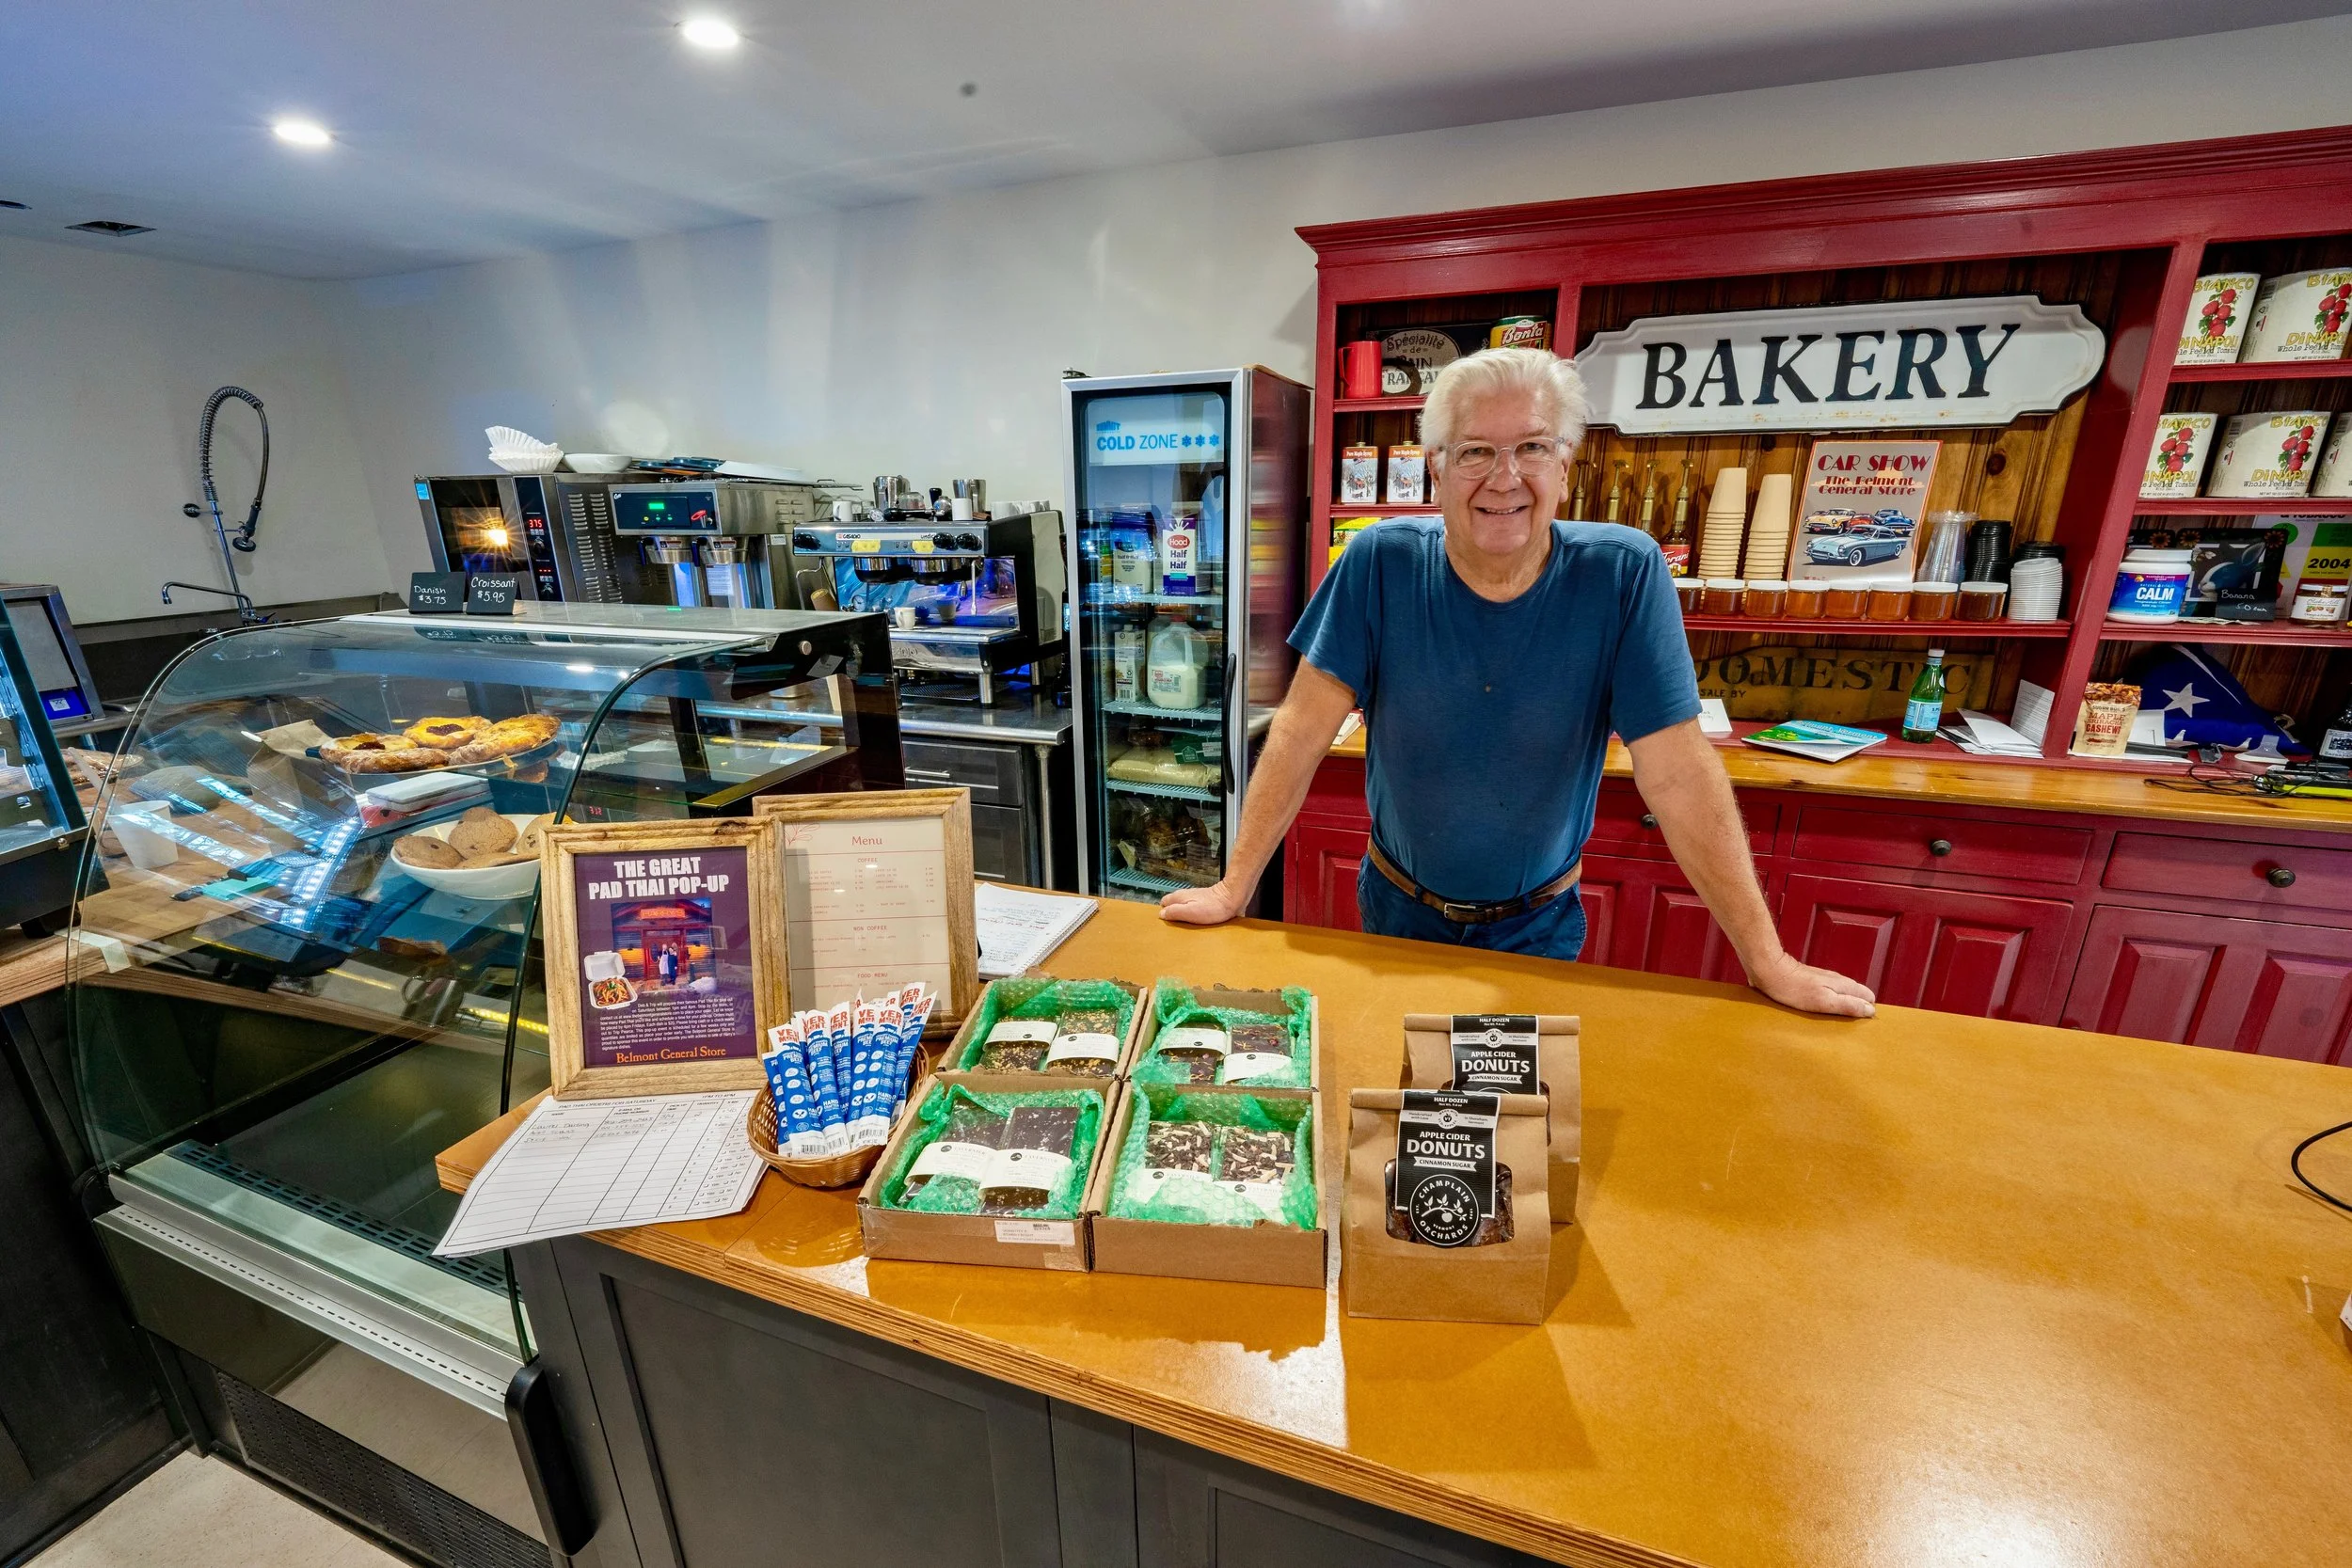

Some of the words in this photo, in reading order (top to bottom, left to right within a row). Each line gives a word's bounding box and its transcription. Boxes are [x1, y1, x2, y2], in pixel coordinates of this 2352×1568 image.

[2278, 344, 2302, 353] Whole
[1635, 324, 2021, 409] BAKERY
[1096, 436, 1136, 451] COLD
[1139, 434, 1178, 450] ZONE
[1818, 455, 1861, 471] CAR
[1867, 455, 1931, 471] SHOW
[1825, 475, 1850, 485] The
[1854, 475, 1915, 485] Belmont
[1819, 484, 1872, 495] General
[1878, 485, 1915, 496] Store
[529, 519, 543, 528] 375
[1169, 537, 1188, 546] Hood
[1170, 550, 1187, 559] Half
[1662, 550, 1690, 563] Torani
[2308, 558, 2351, 569] 2004
[470, 577, 516, 588] Croissant
[414, 585, 446, 594] Danish
[2136, 587, 2174, 600] CALM
[2221, 589, 2255, 600] Banana
[419, 594, 447, 605] $3.75
[477, 590, 505, 603] $5.95
[1697, 649, 1971, 695] OMESTC
[1699, 688, 1724, 698] SALE
[1729, 689, 1747, 699] BY
[2089, 712, 2125, 721] MAPLE
[851, 835, 883, 846] Menu
[613, 859, 646, 879] THE
[649, 857, 701, 877] GREAT
[588, 880, 622, 900] PAD
[626, 878, 665, 897] THAI
[668, 874, 729, 895] POP-UP
[858, 1008, 874, 1018] VE
[880, 1009, 902, 1020] VER
[803, 1016, 825, 1026] VER
[878, 1018, 902, 1026] MONT
[778, 1035, 799, 1043] MON
[875, 1036, 898, 1044] PREMIUM
[616, 1051, 658, 1063] Belmont
[660, 1046, 698, 1060] General
[700, 1046, 725, 1057] Store
[1461, 1058, 1530, 1073] DONUTS
[1420, 1131, 1445, 1140] APPLE
[1445, 1132, 1470, 1142] CIDER
[1406, 1139, 1486, 1159] DONUTS
[1419, 1180, 1470, 1203] CHAMPLAIN
[1420, 1220, 1469, 1240] ORCHARDS
[1433, 1223, 1455, 1231] VERMONT
